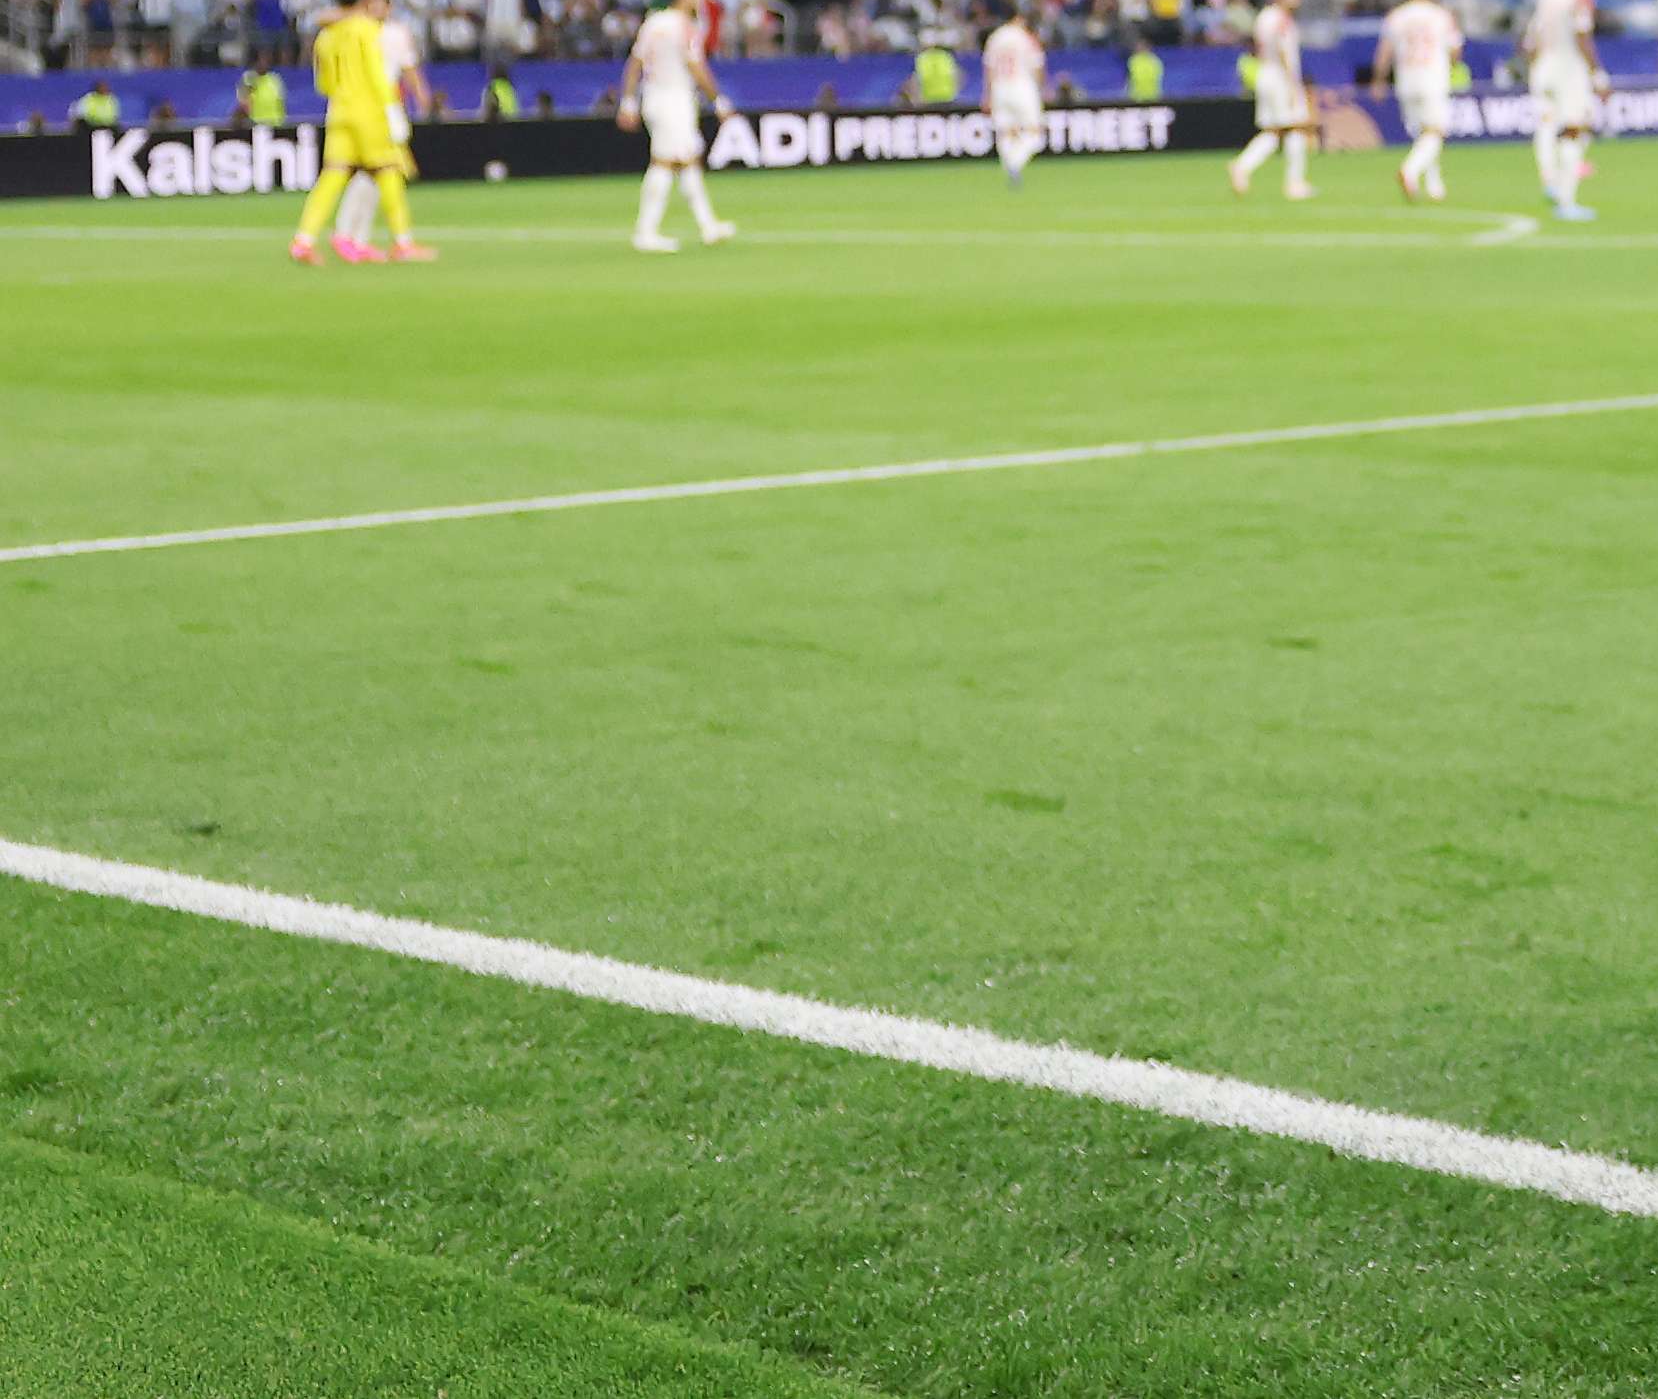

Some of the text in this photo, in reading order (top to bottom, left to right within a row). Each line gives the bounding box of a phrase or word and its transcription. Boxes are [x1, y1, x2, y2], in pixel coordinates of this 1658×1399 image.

[91, 122, 320, 200] Kalshi
[706, 105, 1176, 171] ADI PREDICTREET
